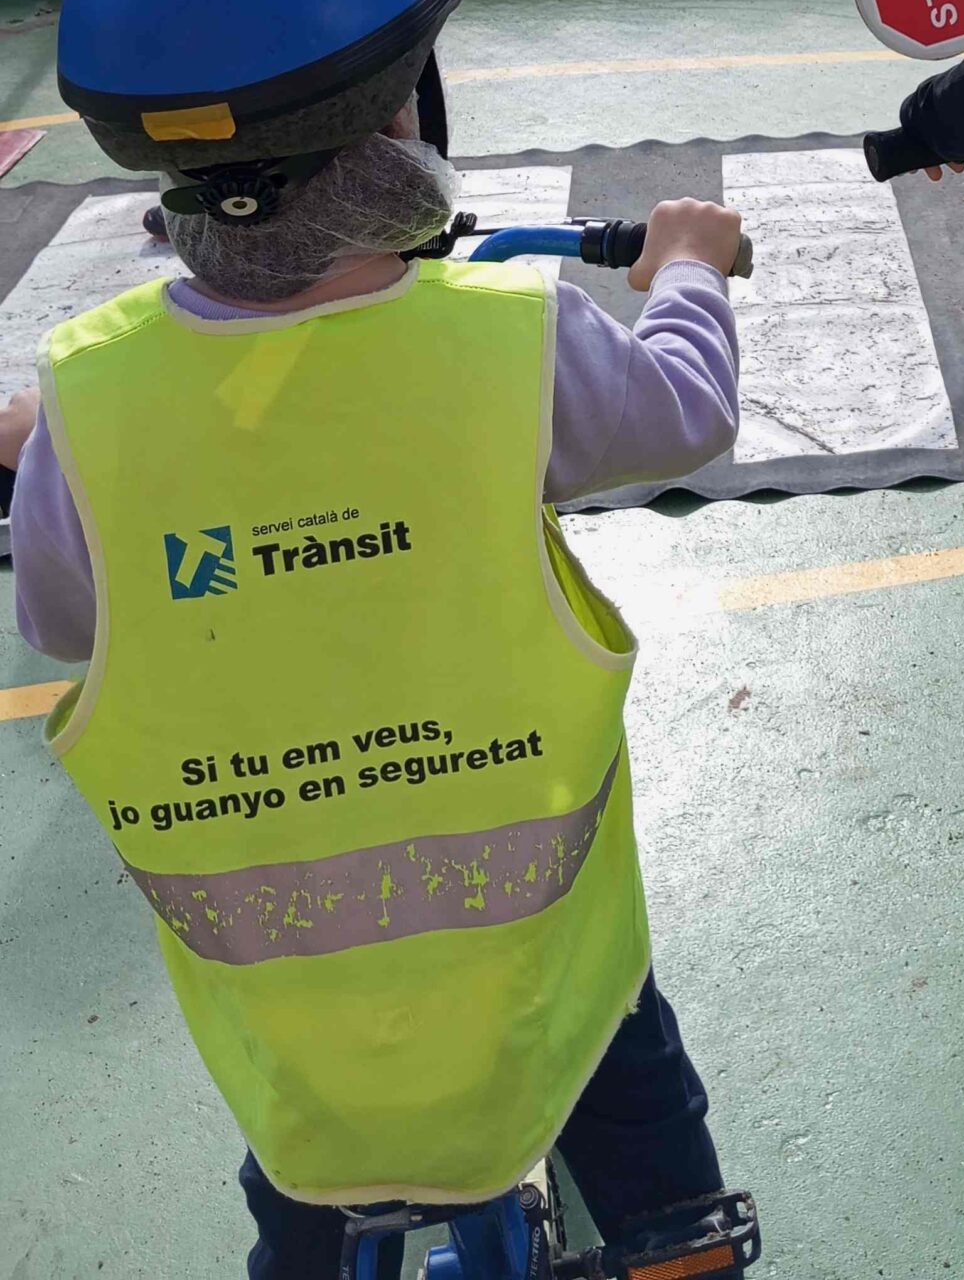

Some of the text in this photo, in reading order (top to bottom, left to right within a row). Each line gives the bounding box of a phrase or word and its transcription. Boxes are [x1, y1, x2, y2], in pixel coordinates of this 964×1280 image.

[252, 507, 360, 536] servei català de
[252, 521, 412, 577] Trànsit
[108, 729, 544, 832] jo guanyo en seguretat
[180, 719, 454, 786] Si tu em veus,
